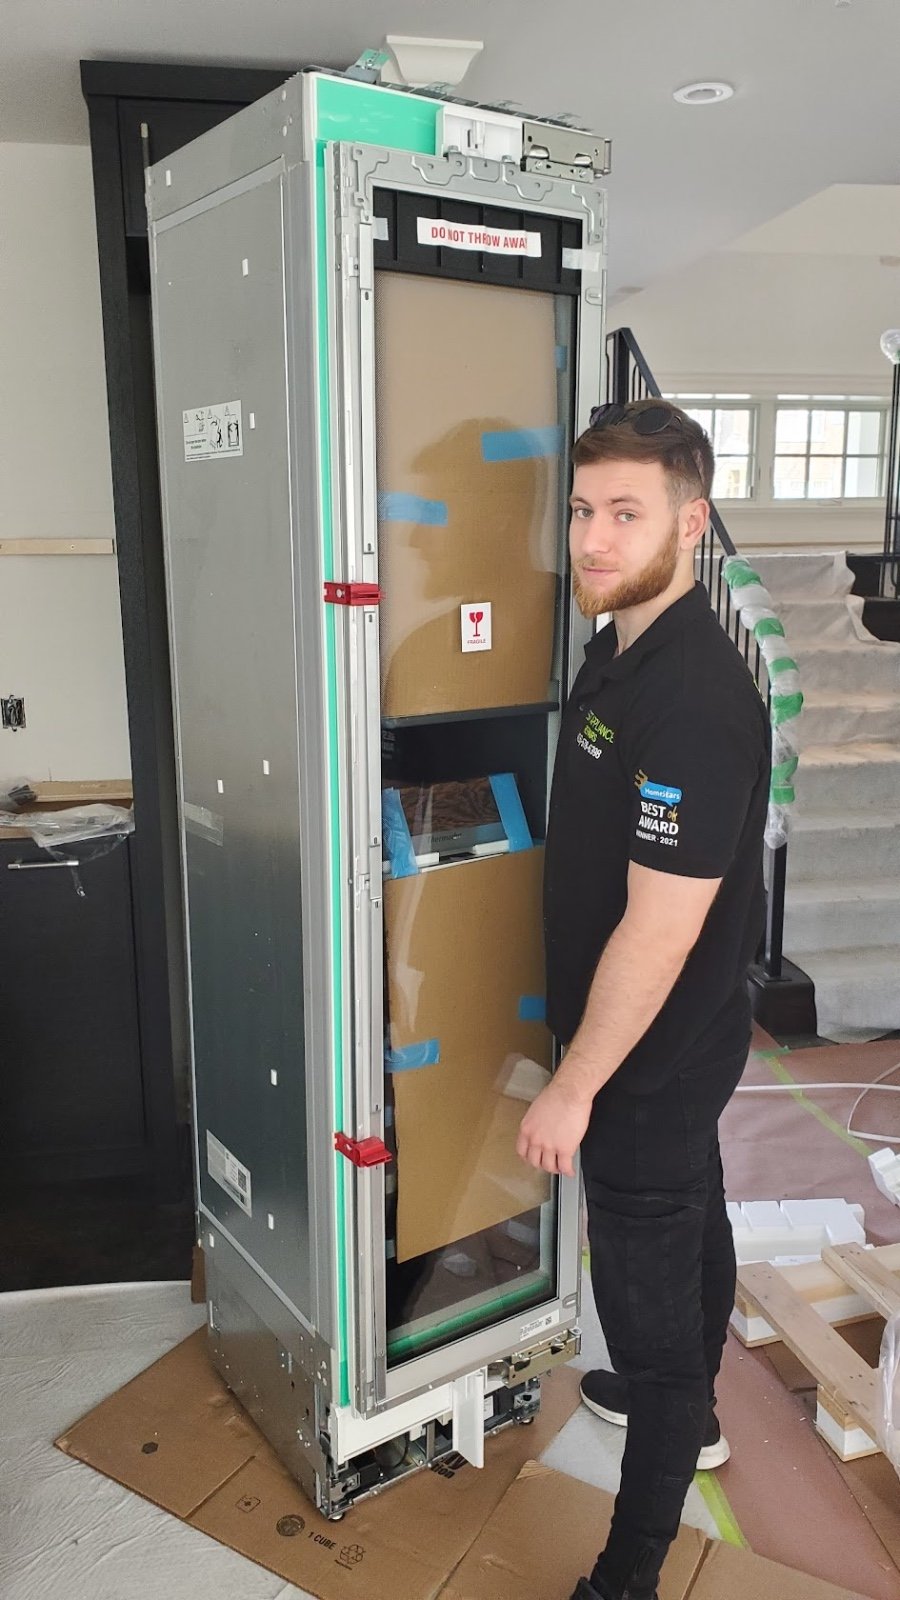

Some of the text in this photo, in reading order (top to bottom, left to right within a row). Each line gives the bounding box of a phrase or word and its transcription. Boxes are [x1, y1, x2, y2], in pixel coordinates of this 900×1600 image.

[431, 226, 446, 239] DO
[447, 229, 465, 243] NOT
[467, 231, 500, 248] THROW
[644, 787, 680, 800] HomeStars
[640, 801, 678, 822] BEST of
[638, 814, 679, 835] AWARD
[659, 836, 678, 847] 2021
[308, 1531, 337, 1550] 1 CUBE
